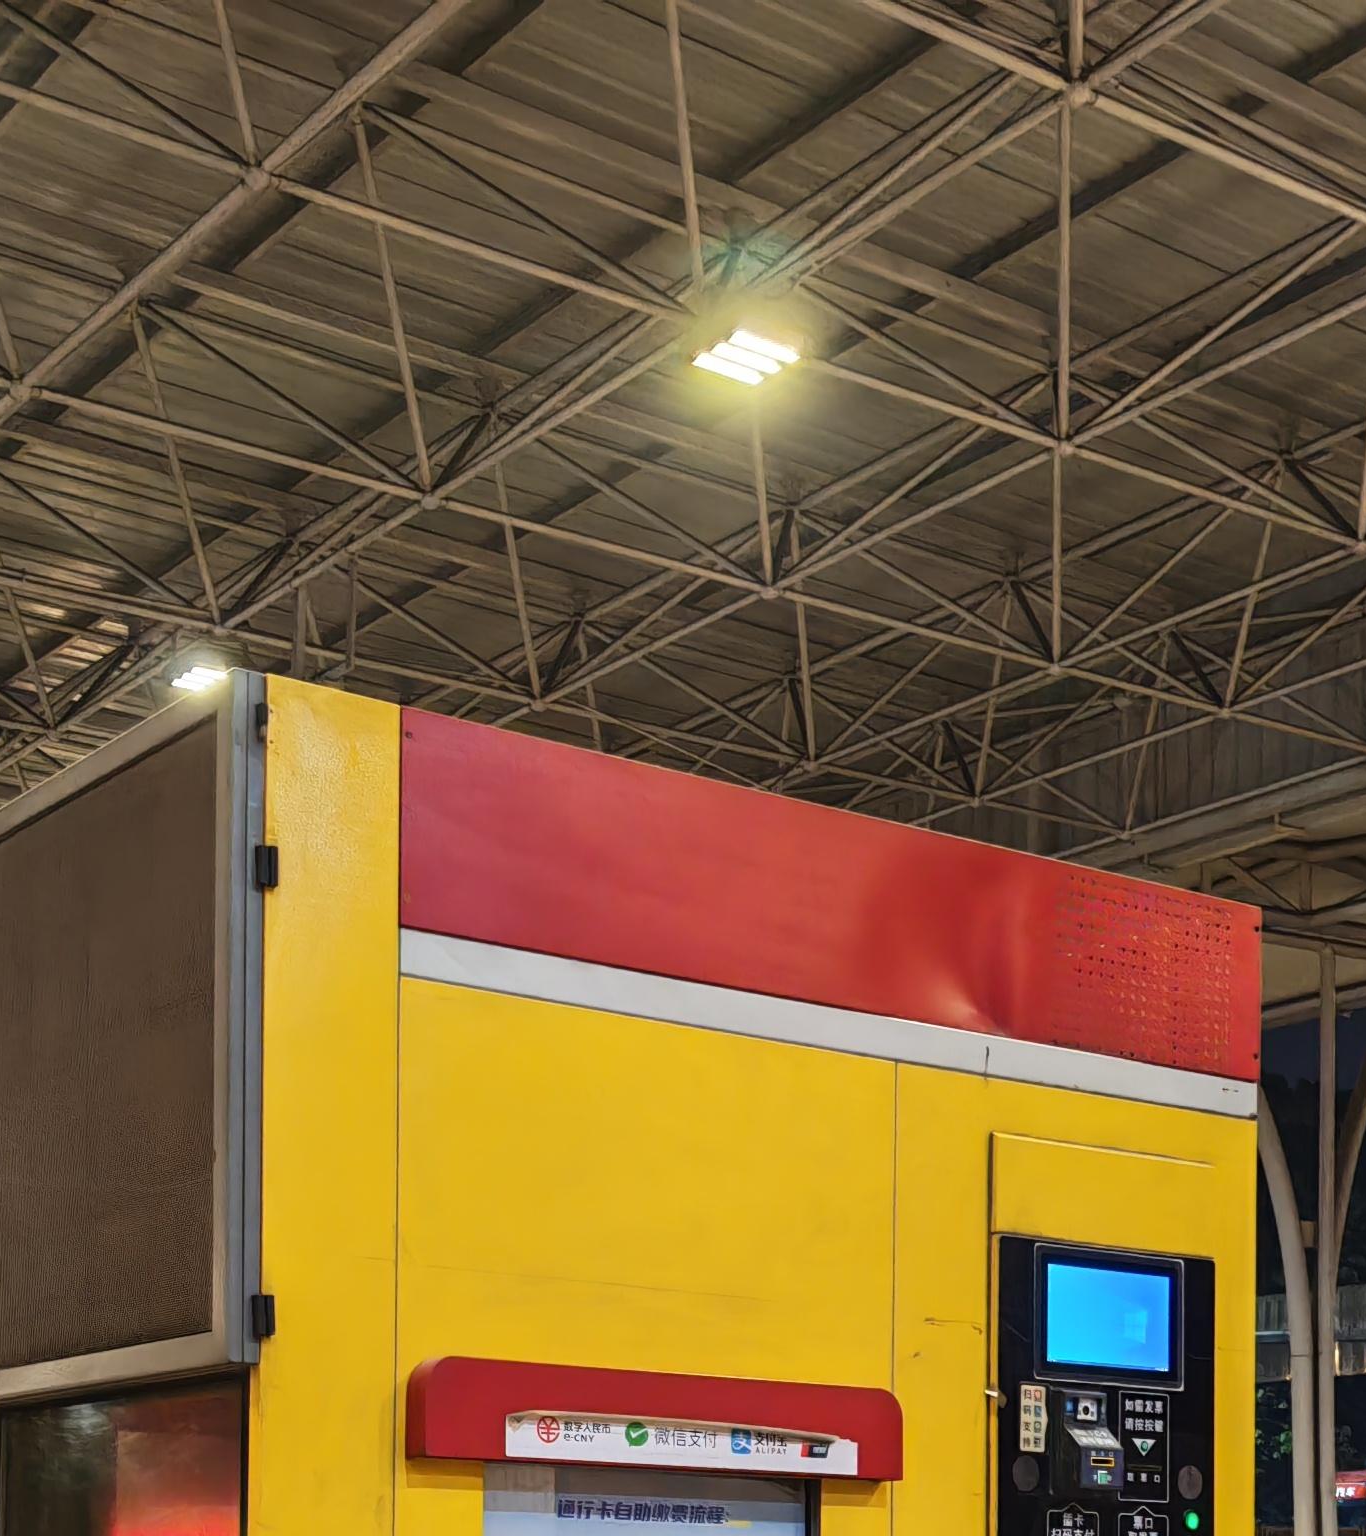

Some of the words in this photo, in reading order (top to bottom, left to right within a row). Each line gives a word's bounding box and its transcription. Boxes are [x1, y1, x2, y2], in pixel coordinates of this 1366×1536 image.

[1125, 1399, 1164, 1414] 如需发票
[563, 1421, 611, 1435] 数字人民币
[1125, 1418, 1164, 1433] 请按按键
[563, 1432, 595, 1443] e-CNY
[654, 1426, 718, 1449] 微信支付
[754, 1447, 788, 1456] ALIPAY
